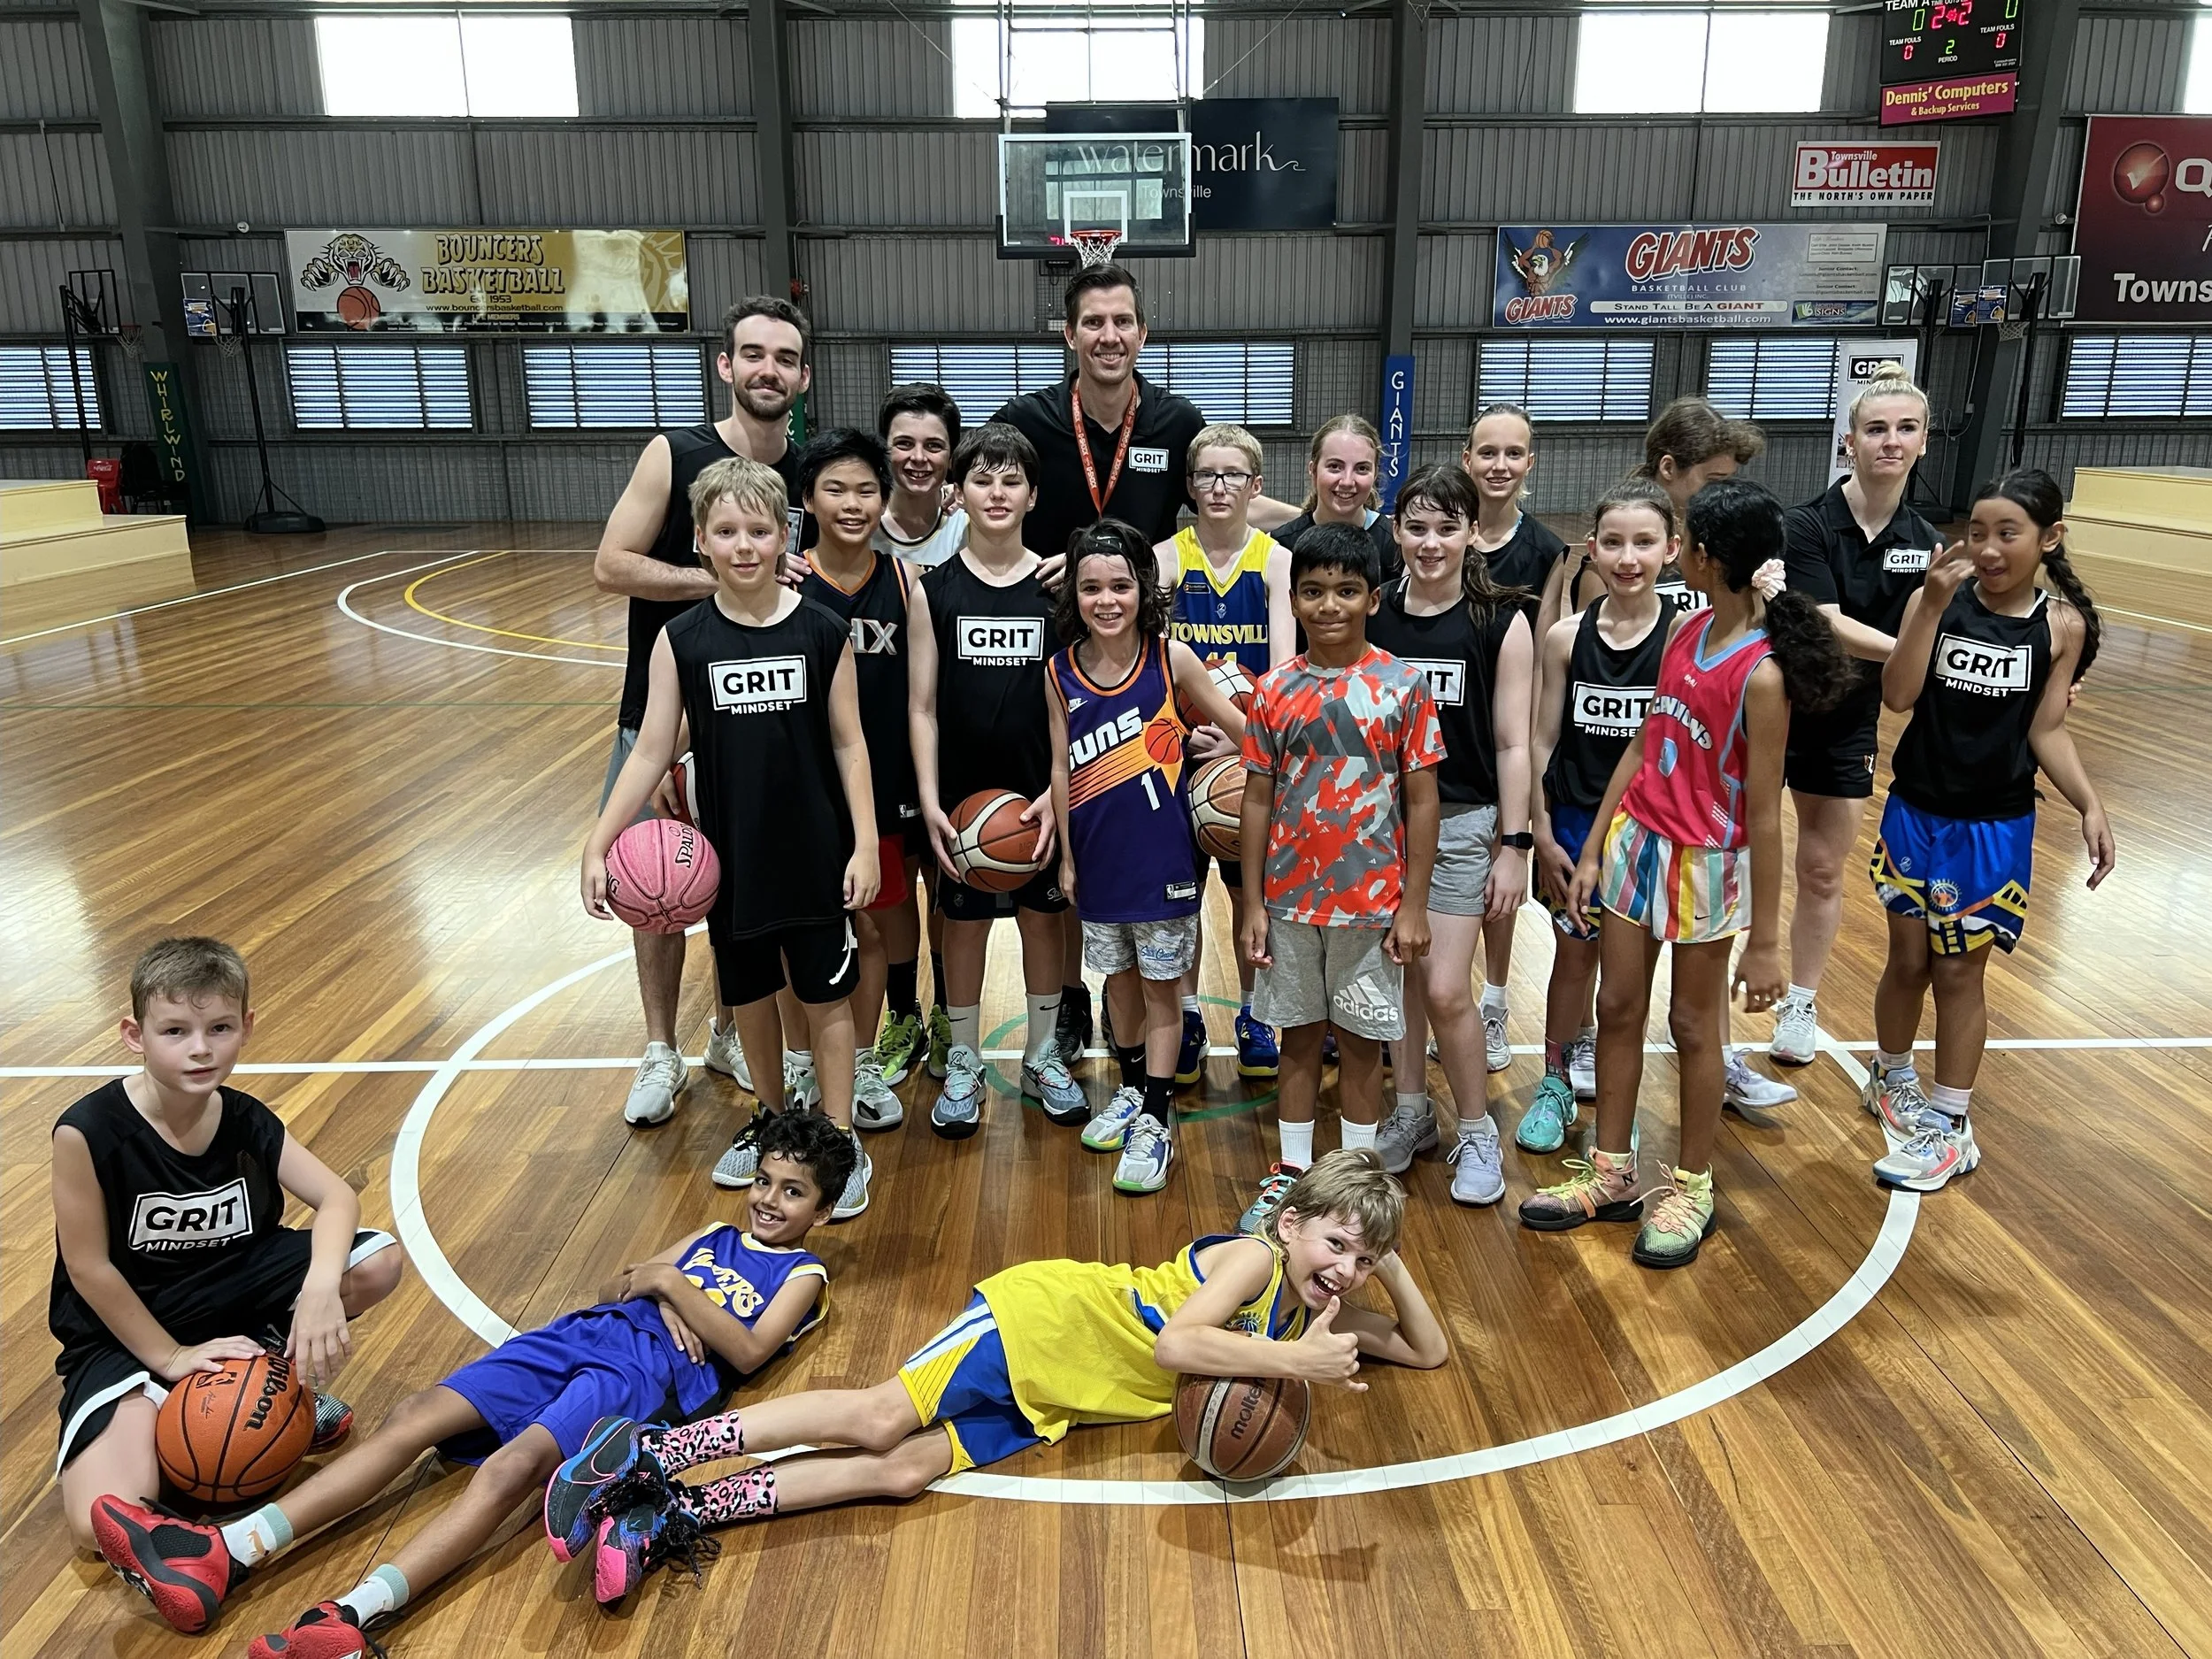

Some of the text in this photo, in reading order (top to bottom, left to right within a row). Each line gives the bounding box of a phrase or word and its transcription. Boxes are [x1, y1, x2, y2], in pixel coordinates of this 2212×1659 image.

[1886, 0, 1917, 11] TEAM
[1946, 40, 1955, 54] 2
[1938, 55, 1958, 64] PERIOD
[1886, 81, 2008, 106] Dennis' Computers
[1910, 102, 1980, 116] & Backup Services
[1832, 150, 1878, 161] Townsville
[1797, 150, 1933, 188] Bulletin
[1793, 192, 1933, 201] THE NORTH'S OWN PAPER
[434, 234, 544, 265] BOUNCERS
[1624, 227, 1762, 283] GIANTS
[420, 266, 565, 294] BASKETBALL
[489, 295, 511, 303] 1953
[1505, 294, 1578, 325] GIANTS
[1604, 315, 1771, 325] www.giantsbasketball.com
[150, 371, 186, 482] WHIRLWIND
[1388, 371, 1404, 477] GIANTS
[1078, 434, 1089, 456] G-SHOCK
[1133, 453, 1164, 465] GRIT
[1086, 466, 1097, 488] G-SHOCK
[1890, 554, 1924, 565] GRIT
[968, 627, 1034, 649] GRIT
[1171, 622, 1268, 645] TOWNSVILL
[973, 657, 1028, 666] MINDSET
[1947, 649, 2017, 679] GRIT
[722, 668, 795, 695] GRIT
[1426, 670, 1454, 692] IT
[1946, 678, 2009, 697] MINDSET
[731, 701, 793, 715] MINDSET
[1583, 695, 1653, 719] GRIT
[1069, 706, 1143, 772] UNS
[1585, 725, 1639, 738] MINDSE
[1141, 772, 1161, 811] 1
[1333, 995, 1399, 1022] adidas
[145, 1195, 238, 1233] GRIT
[146, 1237, 231, 1253] MINDSET
[242, 1356, 290, 1431] Wilson
[1231, 1377, 1267, 1440] molten
